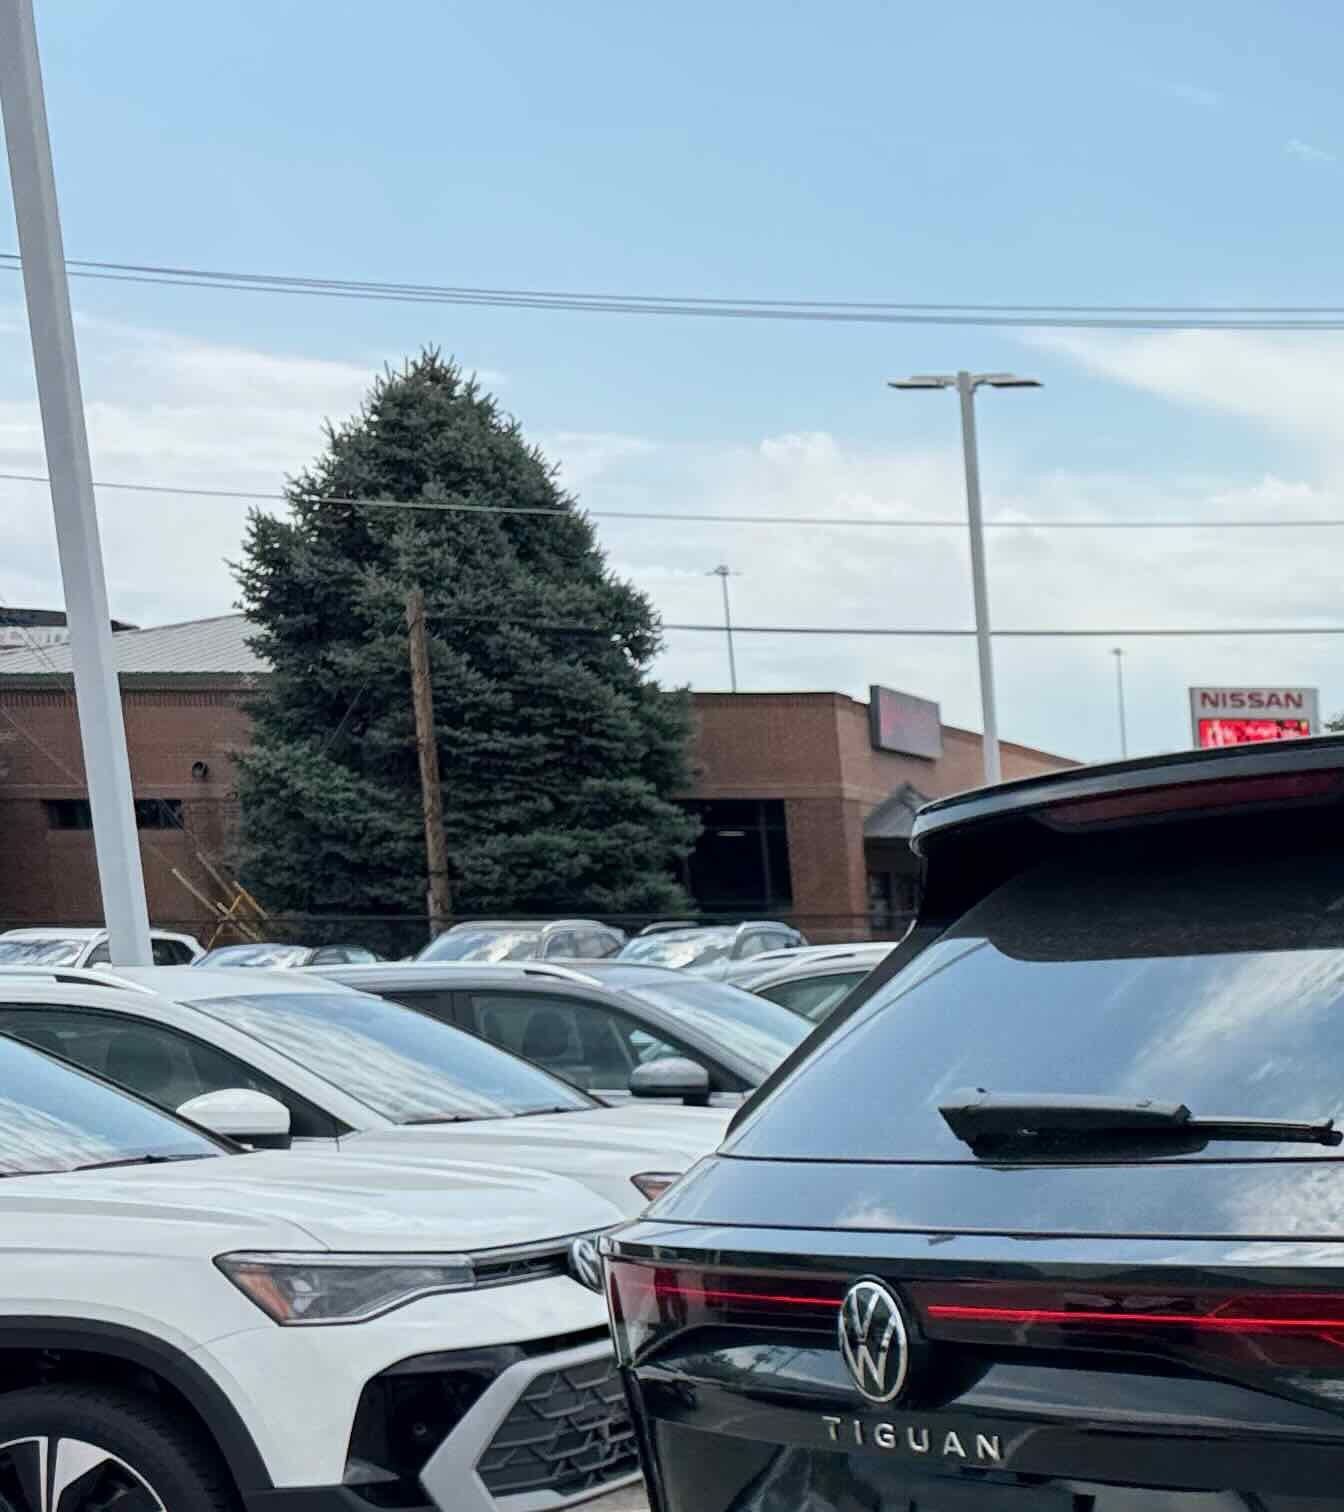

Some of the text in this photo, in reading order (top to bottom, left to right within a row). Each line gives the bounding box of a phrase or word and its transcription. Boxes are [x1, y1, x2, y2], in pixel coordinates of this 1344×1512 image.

[1199, 691, 1303, 709] NISSAN
[838, 1282, 910, 1404] VW
[822, 1415, 1001, 1462] TIGUAN
